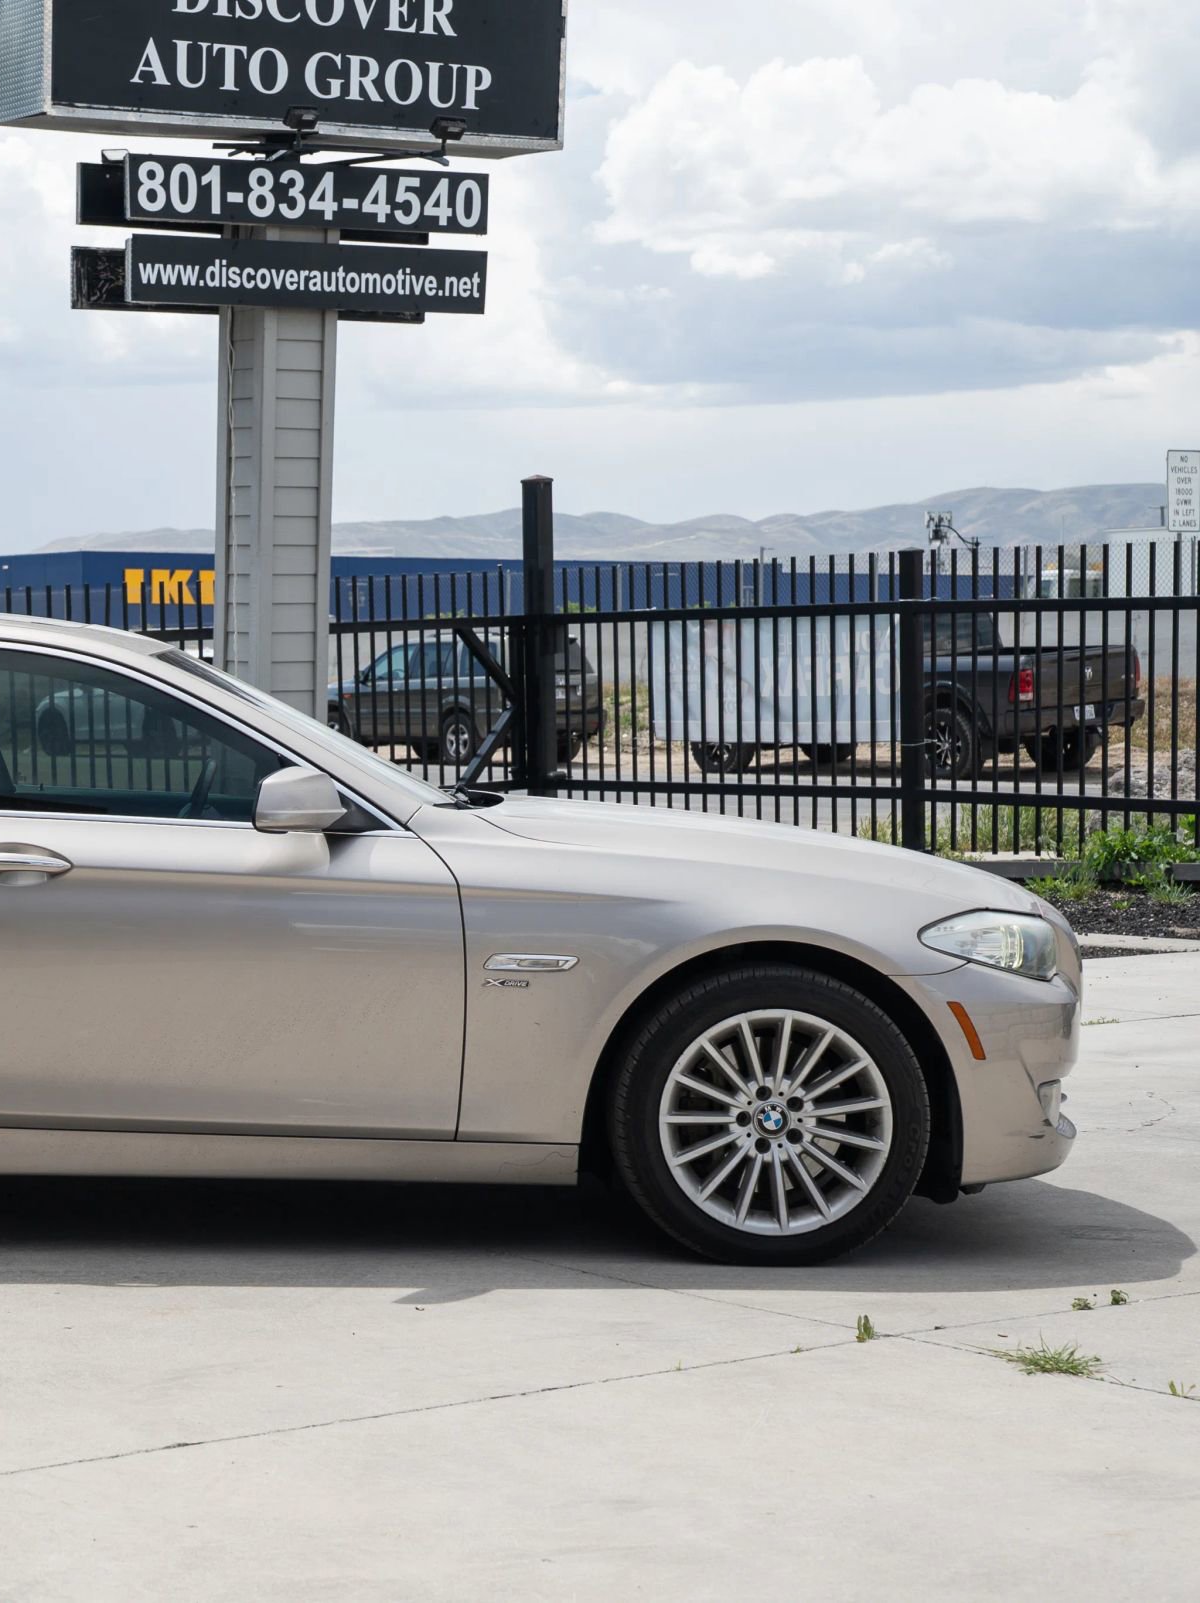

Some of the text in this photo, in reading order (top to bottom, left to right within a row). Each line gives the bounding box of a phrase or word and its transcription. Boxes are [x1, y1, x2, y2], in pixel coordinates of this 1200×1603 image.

[171, 0, 458, 37] OVER
[129, 36, 492, 110] AUTO GROUP
[137, 160, 482, 228] 801-834-4540
[138, 258, 481, 298] www.discoverautomotive.net
[1171, 466, 1198, 474] VEHICLES
[1178, 520, 1197, 528] LANES
[124, 569, 216, 604] IK
